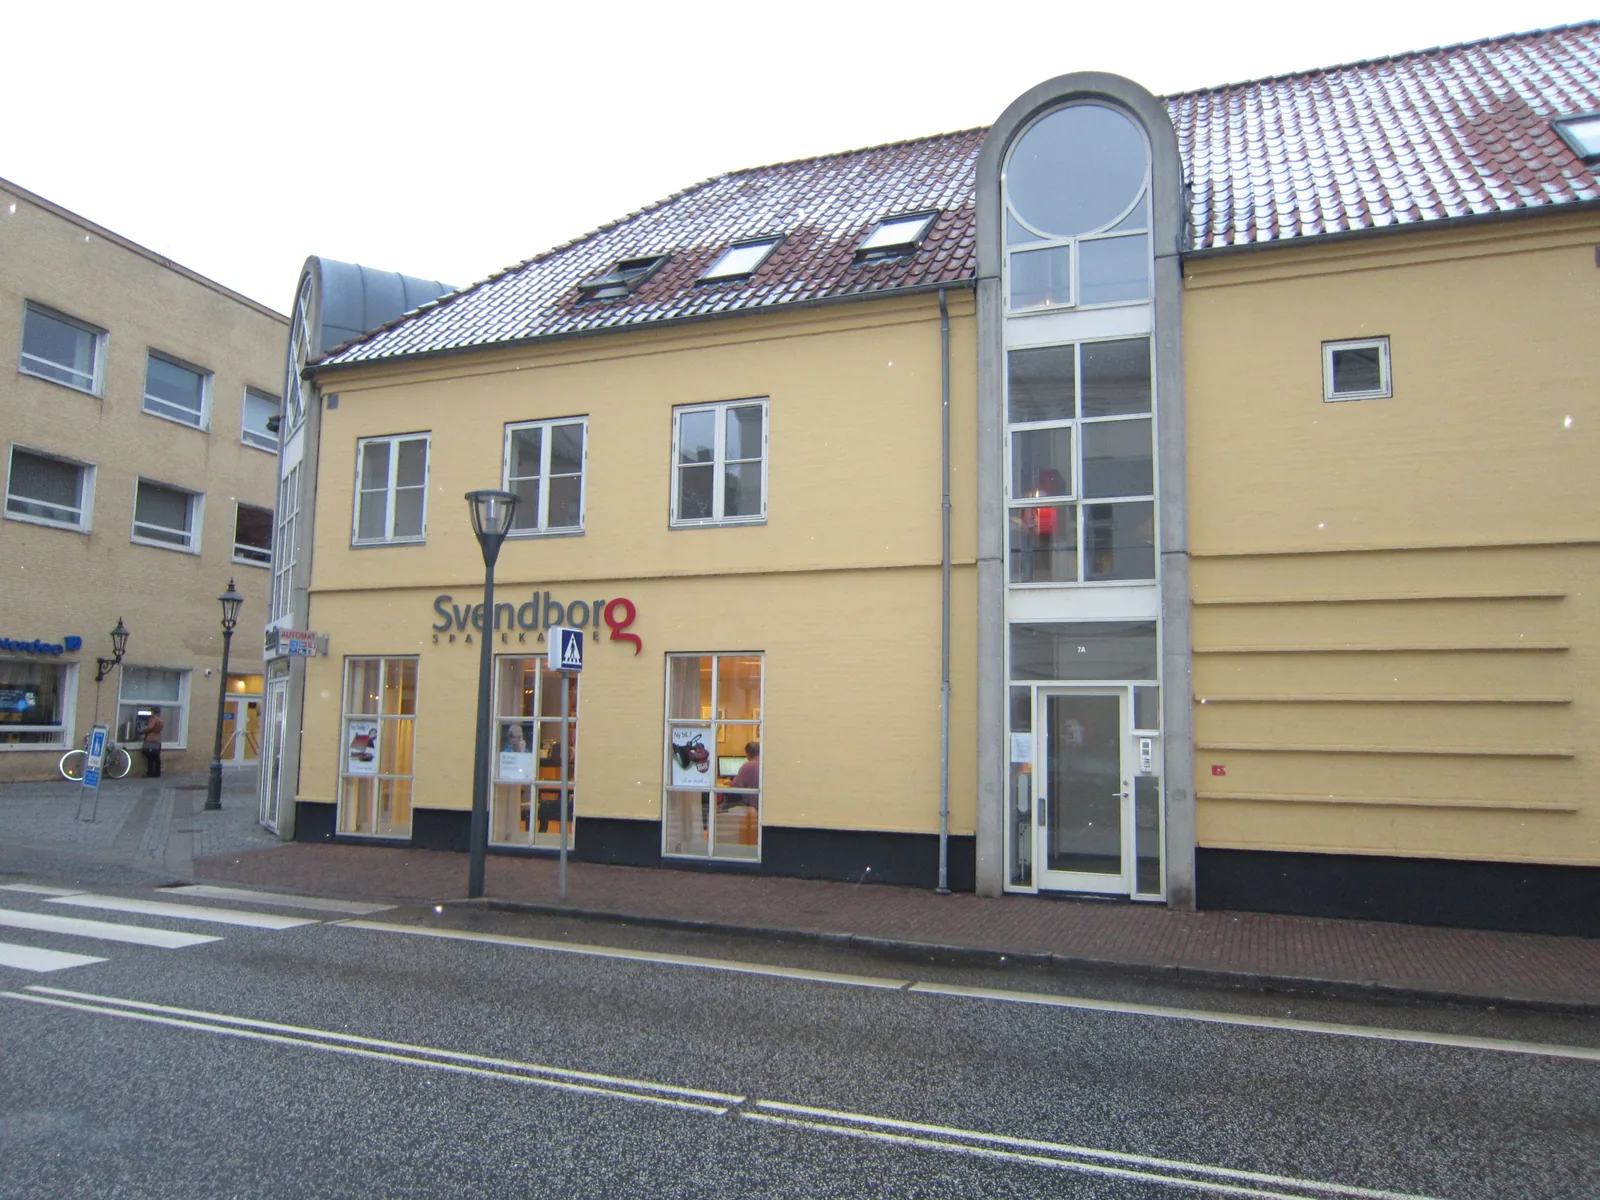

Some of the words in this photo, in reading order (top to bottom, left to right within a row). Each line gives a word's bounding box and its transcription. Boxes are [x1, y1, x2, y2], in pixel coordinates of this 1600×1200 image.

[432, 590, 642, 656] Svendborg
[281, 631, 316, 641] AUTOMAT
[432, 630, 600, 645] SPAEKAE
